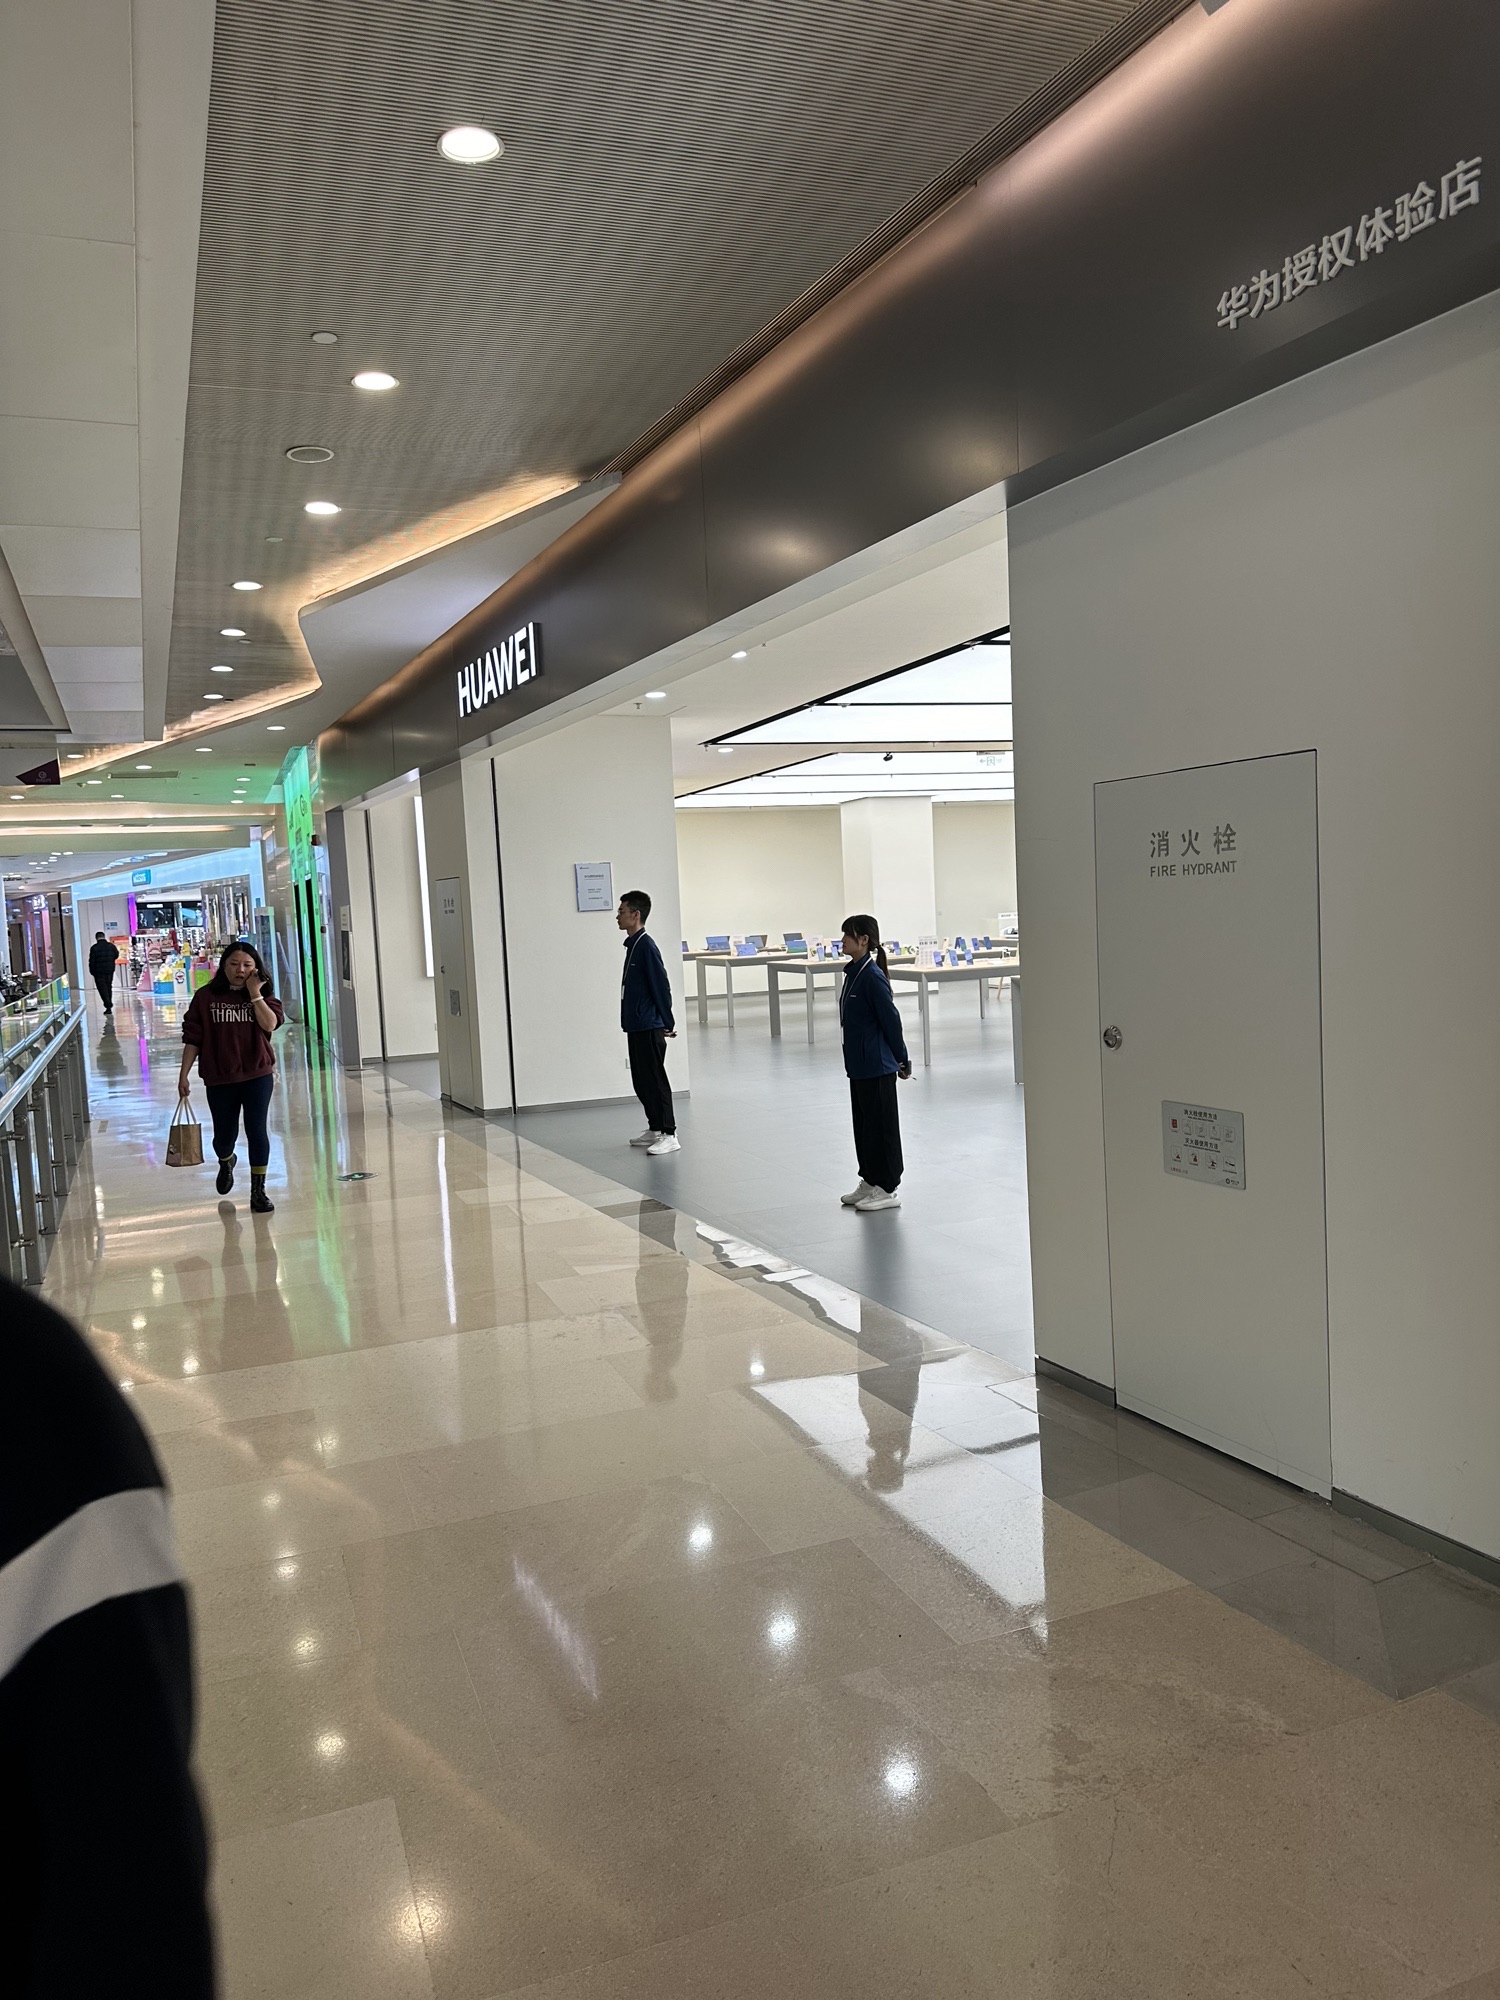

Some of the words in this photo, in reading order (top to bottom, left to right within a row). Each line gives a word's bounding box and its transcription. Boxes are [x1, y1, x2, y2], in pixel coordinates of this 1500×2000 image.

[1216, 156, 1483, 330] 华为授权体验店
[457, 621, 537, 718] HUAWEI
[1150, 823, 1237, 858] 消火栓
[1150, 864, 1177, 877] FIRE
[1182, 860, 1237, 876] HYDRANT
